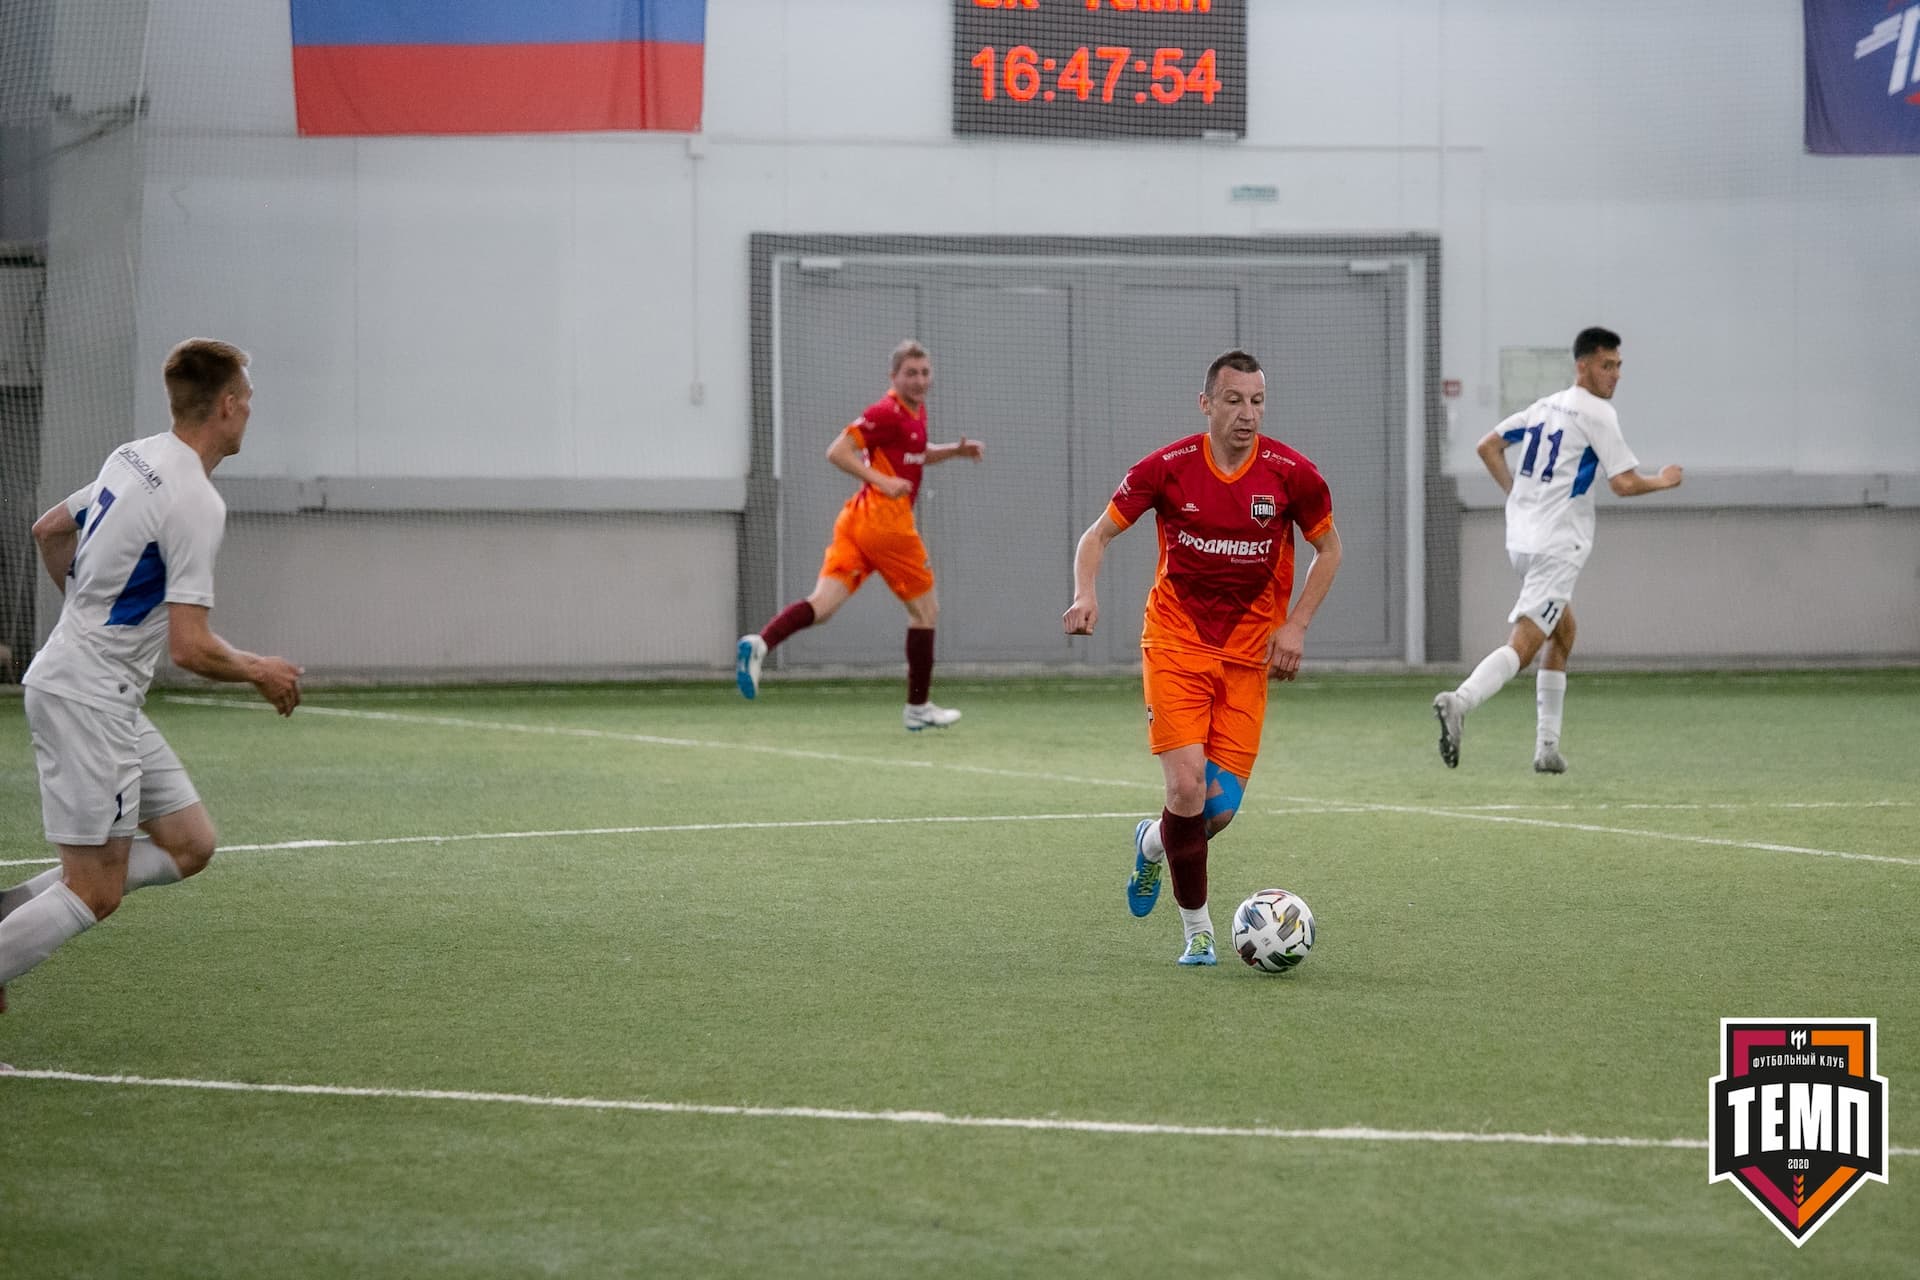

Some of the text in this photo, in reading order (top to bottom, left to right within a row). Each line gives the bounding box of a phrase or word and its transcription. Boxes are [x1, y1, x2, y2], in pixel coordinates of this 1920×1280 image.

[971, 45, 1222, 104] 16:47:54
[1520, 422, 1563, 482] 11
[1178, 530, 1272, 556] ПРОДИНВЕСТ
[1541, 601, 1559, 624] 11
